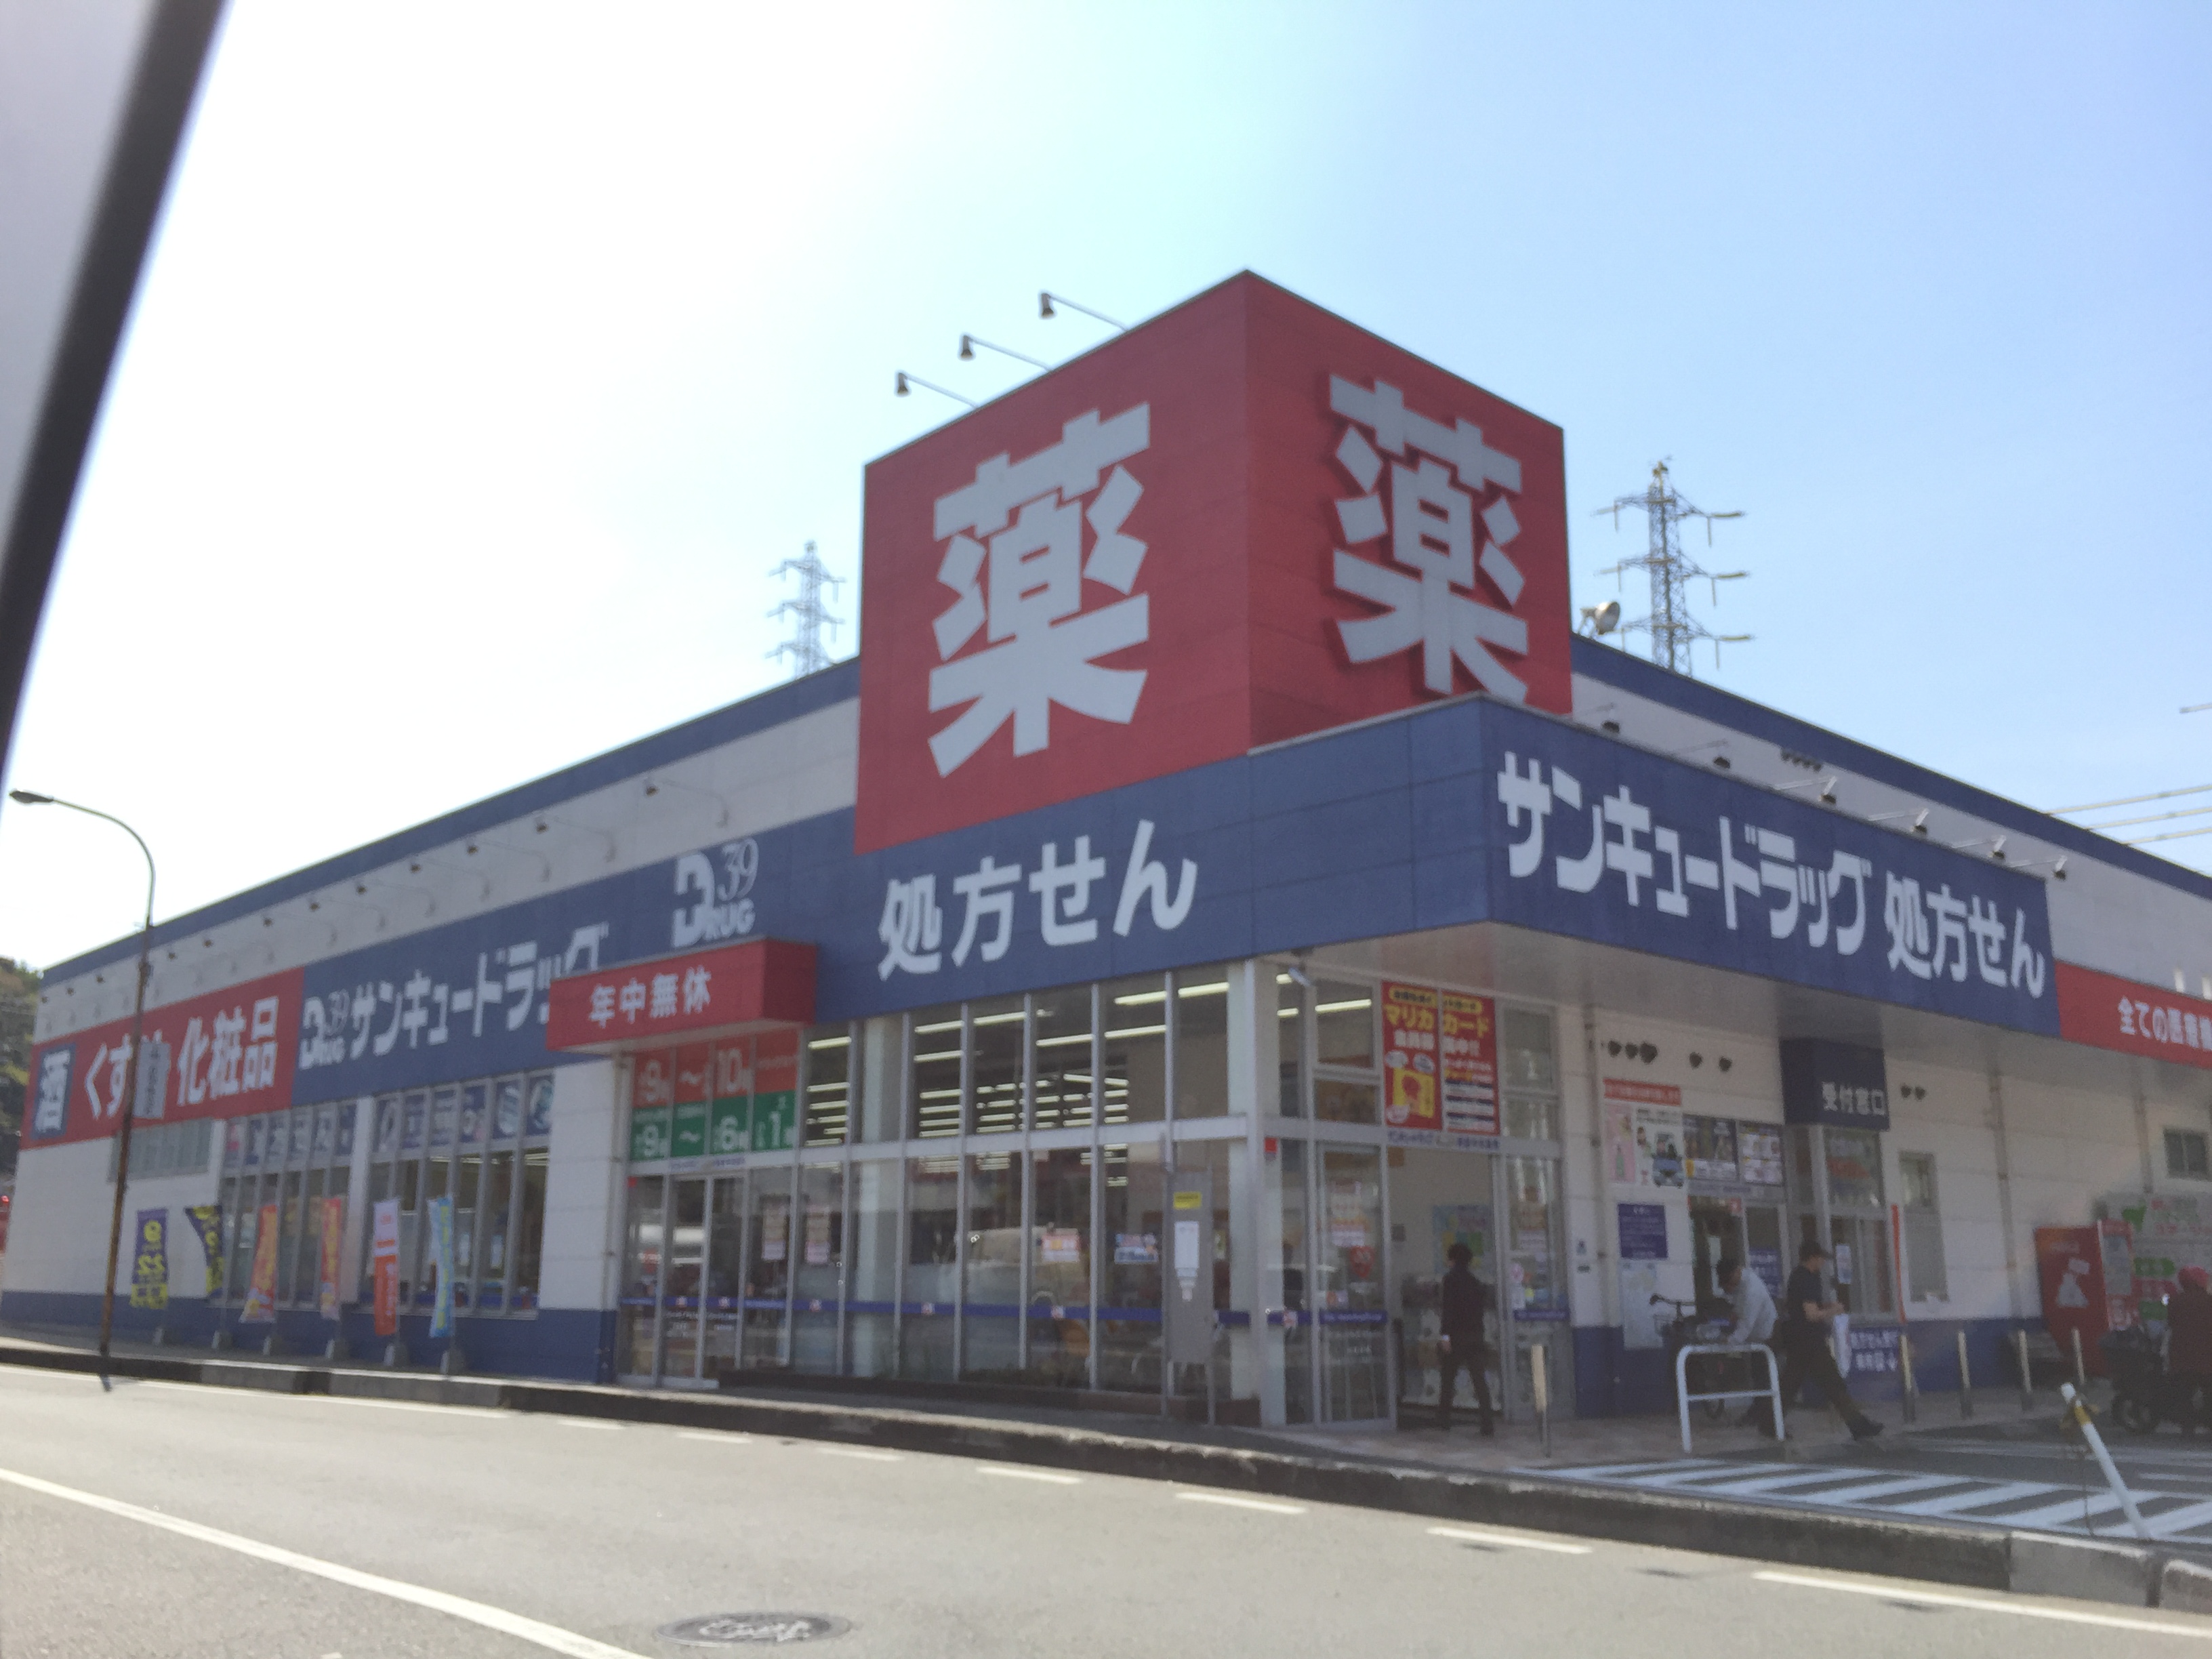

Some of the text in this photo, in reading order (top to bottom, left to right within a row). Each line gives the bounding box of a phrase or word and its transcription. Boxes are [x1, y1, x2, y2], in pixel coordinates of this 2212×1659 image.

[928, 401, 1150, 778] 薬
[1330, 373, 1528, 705] 薬
[878, 820, 1198, 981] 処方せん
[1497, 751, 2045, 1000] サンキュードラッグ 処方せん
[85, 1029, 163, 1120] くす
[178, 996, 279, 1106] 化粧品
[590, 965, 712, 1028] 年中無休
